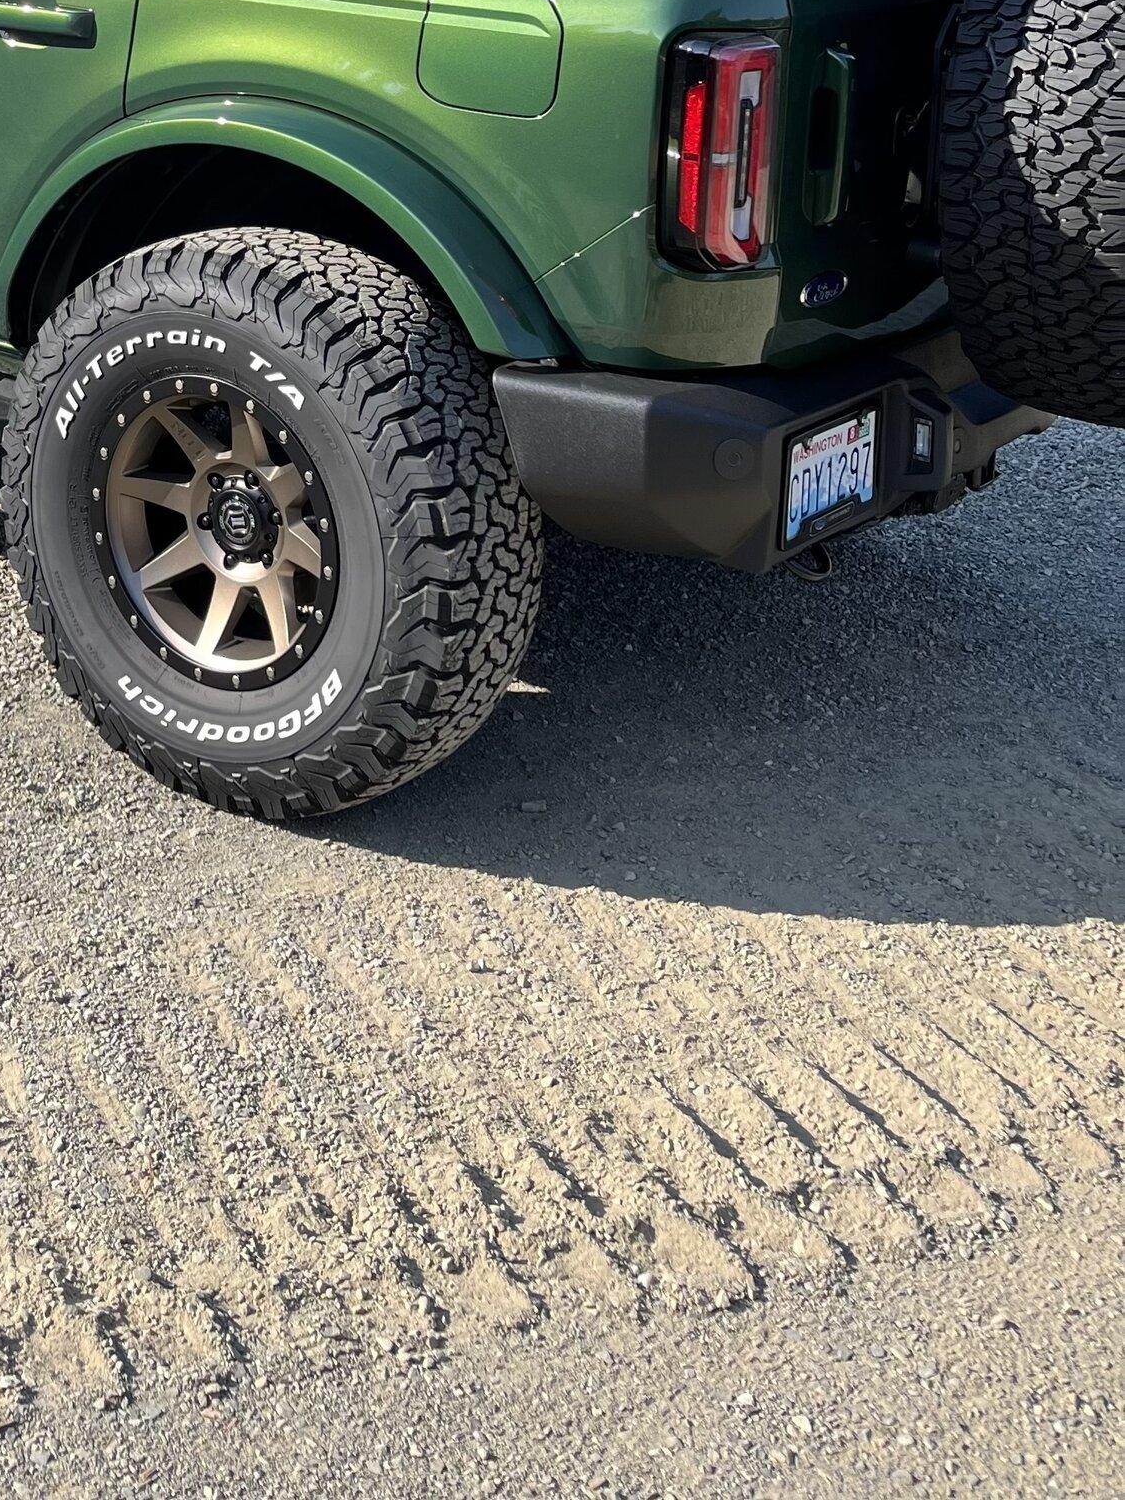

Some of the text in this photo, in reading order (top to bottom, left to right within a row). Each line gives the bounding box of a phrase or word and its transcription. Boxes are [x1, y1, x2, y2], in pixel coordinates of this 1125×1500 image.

[55, 328, 305, 440] All-Terrain T/A
[789, 441, 872, 523] CDY1297
[793, 432, 843, 464] WASHINGTON
[117, 668, 343, 743] BFGoodrich
